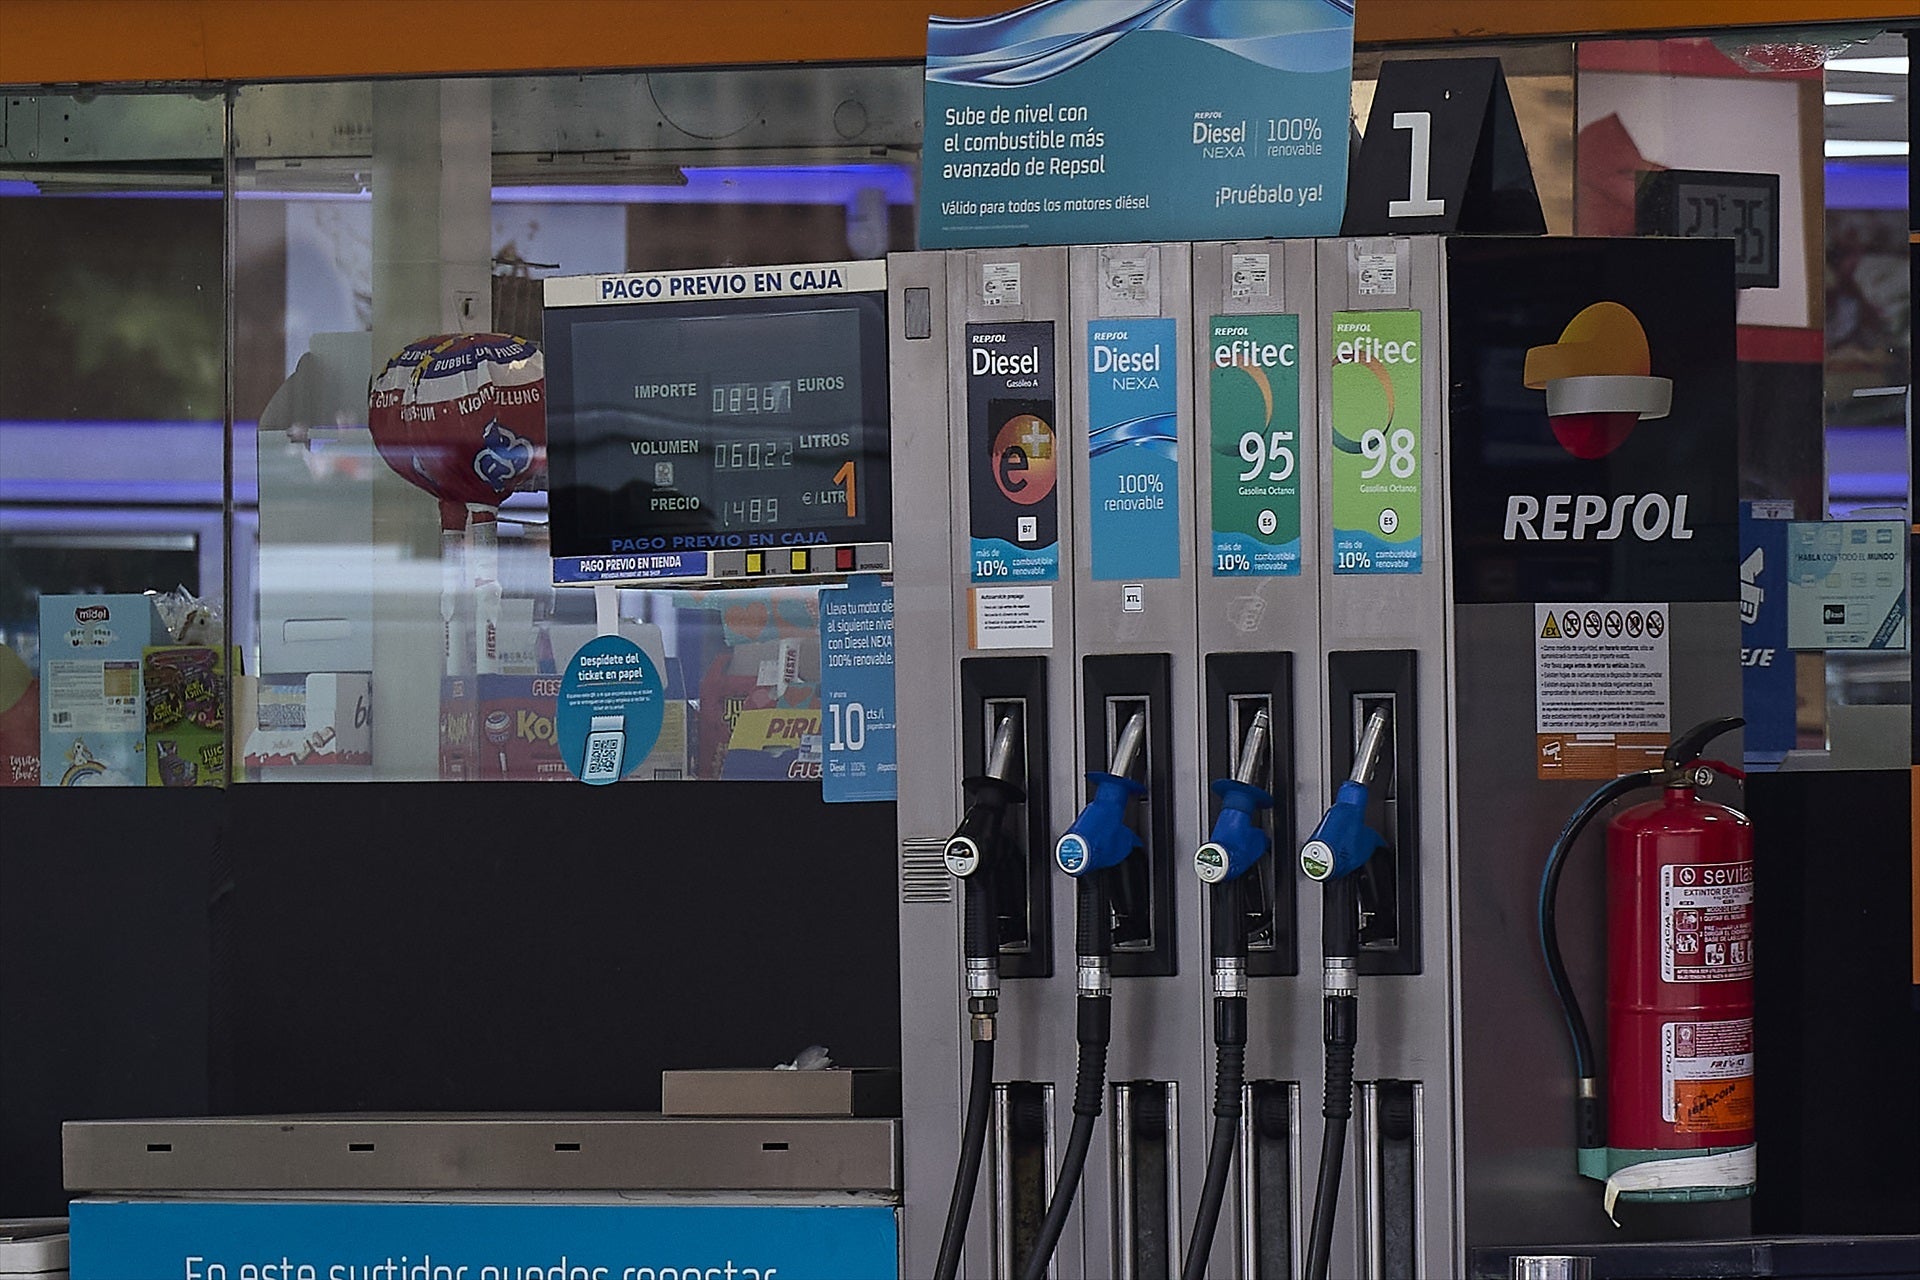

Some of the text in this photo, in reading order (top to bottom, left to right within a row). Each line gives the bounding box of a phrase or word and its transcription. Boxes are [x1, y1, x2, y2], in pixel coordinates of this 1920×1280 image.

[946, 104, 1088, 126] Sube de nivel con
[1193, 120, 1246, 144] Diesel
[1268, 118, 1322, 142] 100%
[944, 128, 1105, 152] el combustible más
[1203, 146, 1246, 159] NEXA
[1268, 142, 1322, 157] renovable
[943, 154, 1105, 179] avanzado de Repsol
[1389, 112, 1445, 217] 1
[1216, 184, 1323, 208] ¡Pruébalo ya!
[942, 194, 1150, 217] Válido para todos los motores diésel
[602, 270, 843, 299] PAGO PREVIO EN CAJA
[1214, 327, 1249, 336] REPSOL
[1337, 324, 1371, 332] REPSOL
[972, 334, 1007, 343] REPSOL
[1094, 332, 1128, 341] REPSOL
[1094, 344, 1160, 373] Diesel
[1214, 341, 1294, 368] efitec
[1337, 337, 1417, 364] efitec
[433, 354, 472, 372] BUBBLE
[972, 347, 1039, 375] Diesel
[634, 384, 697, 399] IMPORTE
[798, 376, 845, 392] EUROS
[1113, 377, 1160, 390] NEXA
[630, 440, 699, 455] VOLUMEN
[800, 433, 849, 449] LITROS
[1239, 431, 1295, 482] 95
[1361, 428, 1416, 479] 98
[833, 462, 856, 518] 1
[1118, 474, 1164, 494] 100%
[1238, 486, 1295, 496] Gasolina Octanos
[1360, 484, 1417, 493] Gasolina Octanos
[651, 497, 700, 511] PRECIO
[821, 490, 847, 504] LITR
[1104, 498, 1164, 511] renovable
[1262, 518, 1272, 526] E5
[1504, 493, 1693, 541] REPSOL
[1022, 525, 1032, 533] B7
[612, 532, 828, 551] PAGO PREVIO EN CAJA
[1233, 543, 1242, 551] de
[1354, 541, 1363, 549] de
[976, 548, 1000, 557] más de
[1338, 552, 1371, 569] 10%
[580, 556, 682, 572] PAGO PREVIO EN TIENDA
[976, 560, 1008, 576] 10%
[1012, 558, 1053, 566] combustible
[1218, 554, 1250, 571] 10%
[1254, 562, 1289, 571] renovable
[1376, 560, 1409, 568] renovable
[1012, 566, 1045, 575] renovable
[1126, 595, 1140, 603] XTL
[826, 602, 847, 615] Lleva
[848, 603, 857, 614] tu
[858, 602, 880, 614] motor
[828, 618, 894, 635] al siguiente nivel
[1546, 628, 1556, 636] EX
[828, 636, 893, 649] con Diesel NEXA
[580, 653, 639, 668] Despídete del
[829, 654, 852, 667] 100%
[578, 667, 643, 681] ticket en papel
[532, 680, 561, 697] FIES
[830, 702, 865, 751] 10
[789, 760, 823, 778] FIE
[1684, 888, 1720, 896] EXTINTOR
